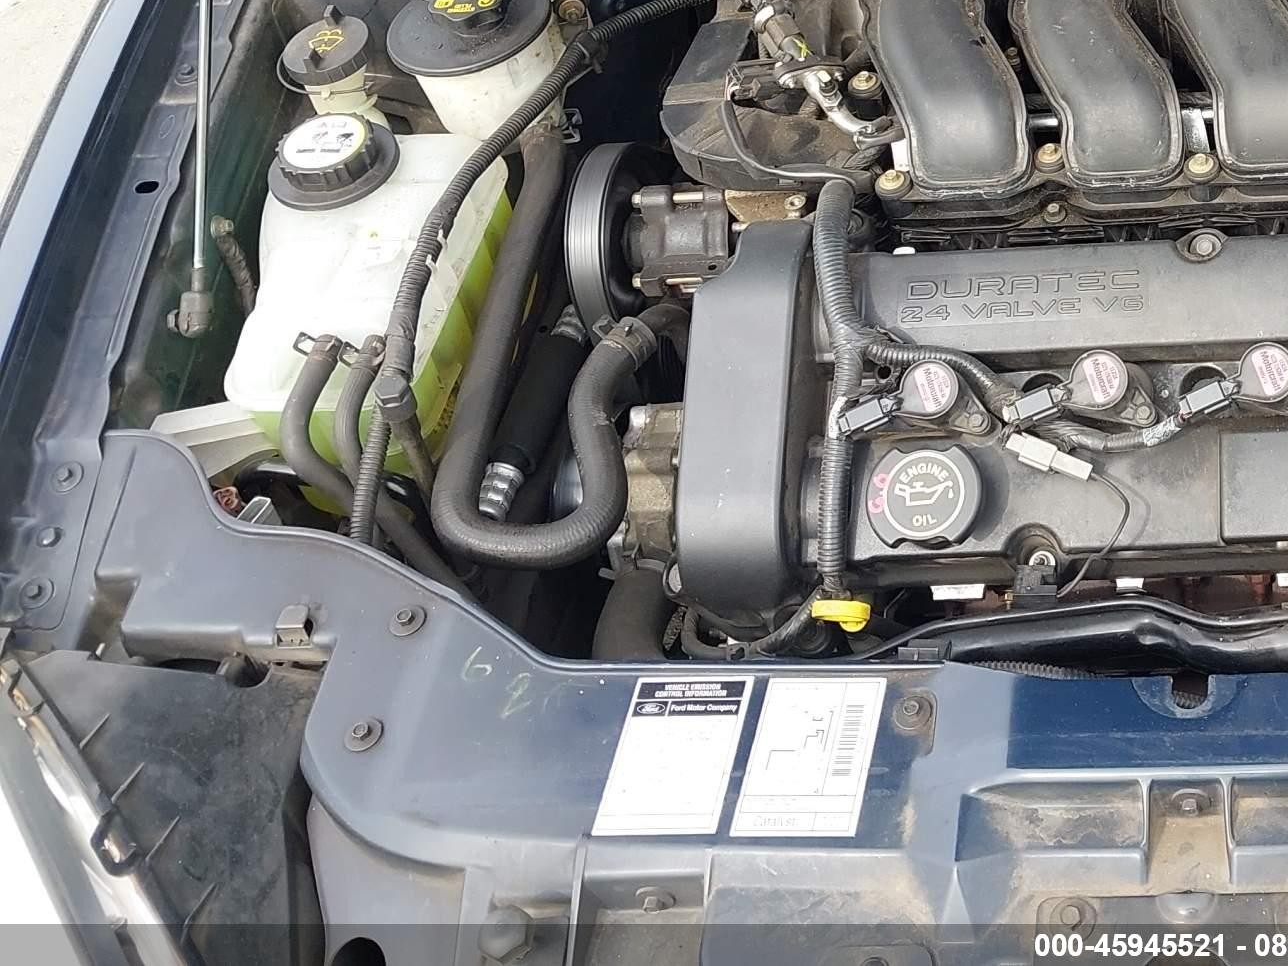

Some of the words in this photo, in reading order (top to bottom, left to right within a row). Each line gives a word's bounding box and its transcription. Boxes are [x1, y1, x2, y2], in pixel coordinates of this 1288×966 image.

[907, 269, 1140, 300] DURATEC
[900, 304, 950, 323] 24
[962, 297, 1081, 319] VALVE
[1095, 294, 1144, 312] V6
[1091, 358, 1111, 399] Motorcraft
[1260, 350, 1281, 392] Motorcraft
[923, 368, 943, 408] Motorcraft
[899, 462, 950, 484] ENGINE
[912, 513, 938, 527] OIL
[654, 690, 684, 698] CONTROL
[684, 690, 727, 698] INFORMATION
[665, 683, 690, 691] VEHICLE
[690, 682, 722, 691] EMISSION
[670, 704, 686, 712] Ford
[686, 704, 707, 712] Motor
[707, 703, 738, 714] Company
